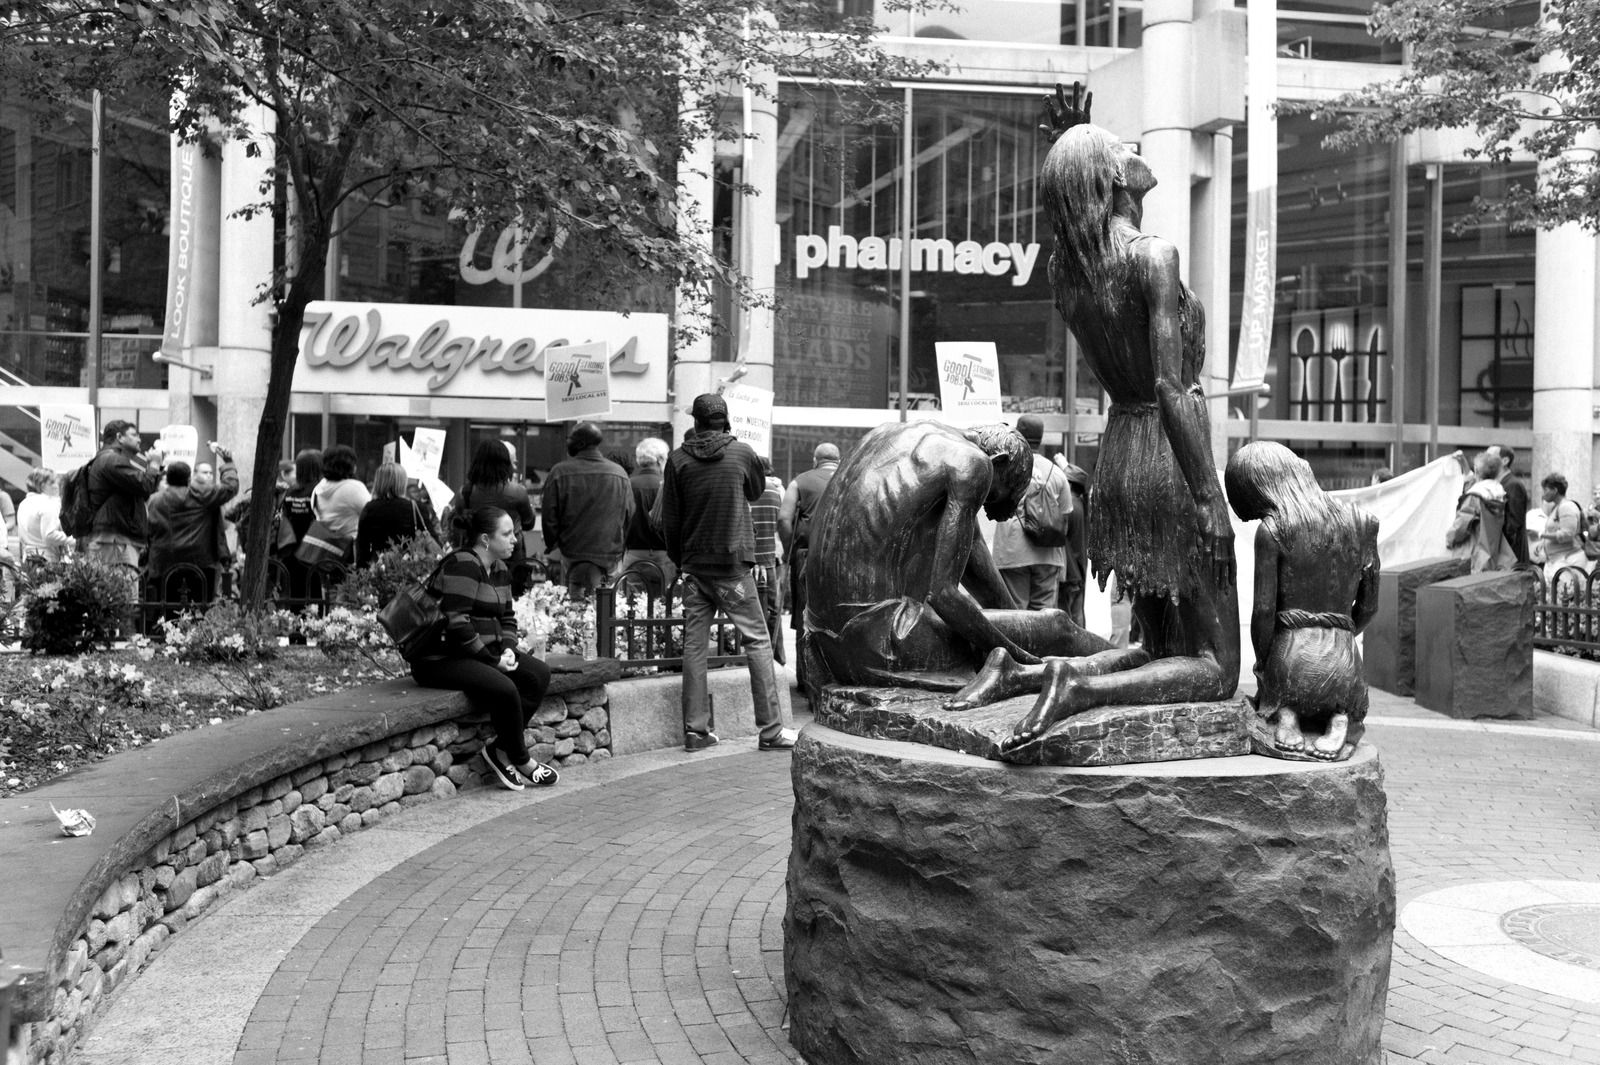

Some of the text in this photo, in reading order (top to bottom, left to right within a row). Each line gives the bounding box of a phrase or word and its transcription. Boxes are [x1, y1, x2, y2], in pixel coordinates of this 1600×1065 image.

[171, 149, 193, 338] LOOK BOUTIQUE
[1249, 229, 1269, 349] UP MARKET
[303, 308, 650, 391] Walgres
[549, 361, 605, 374] GOOD STRONG
[944, 359, 995, 378] GOOD STRONG
[549, 372, 570, 383] JOBS
[945, 372, 964, 387] JOBS
